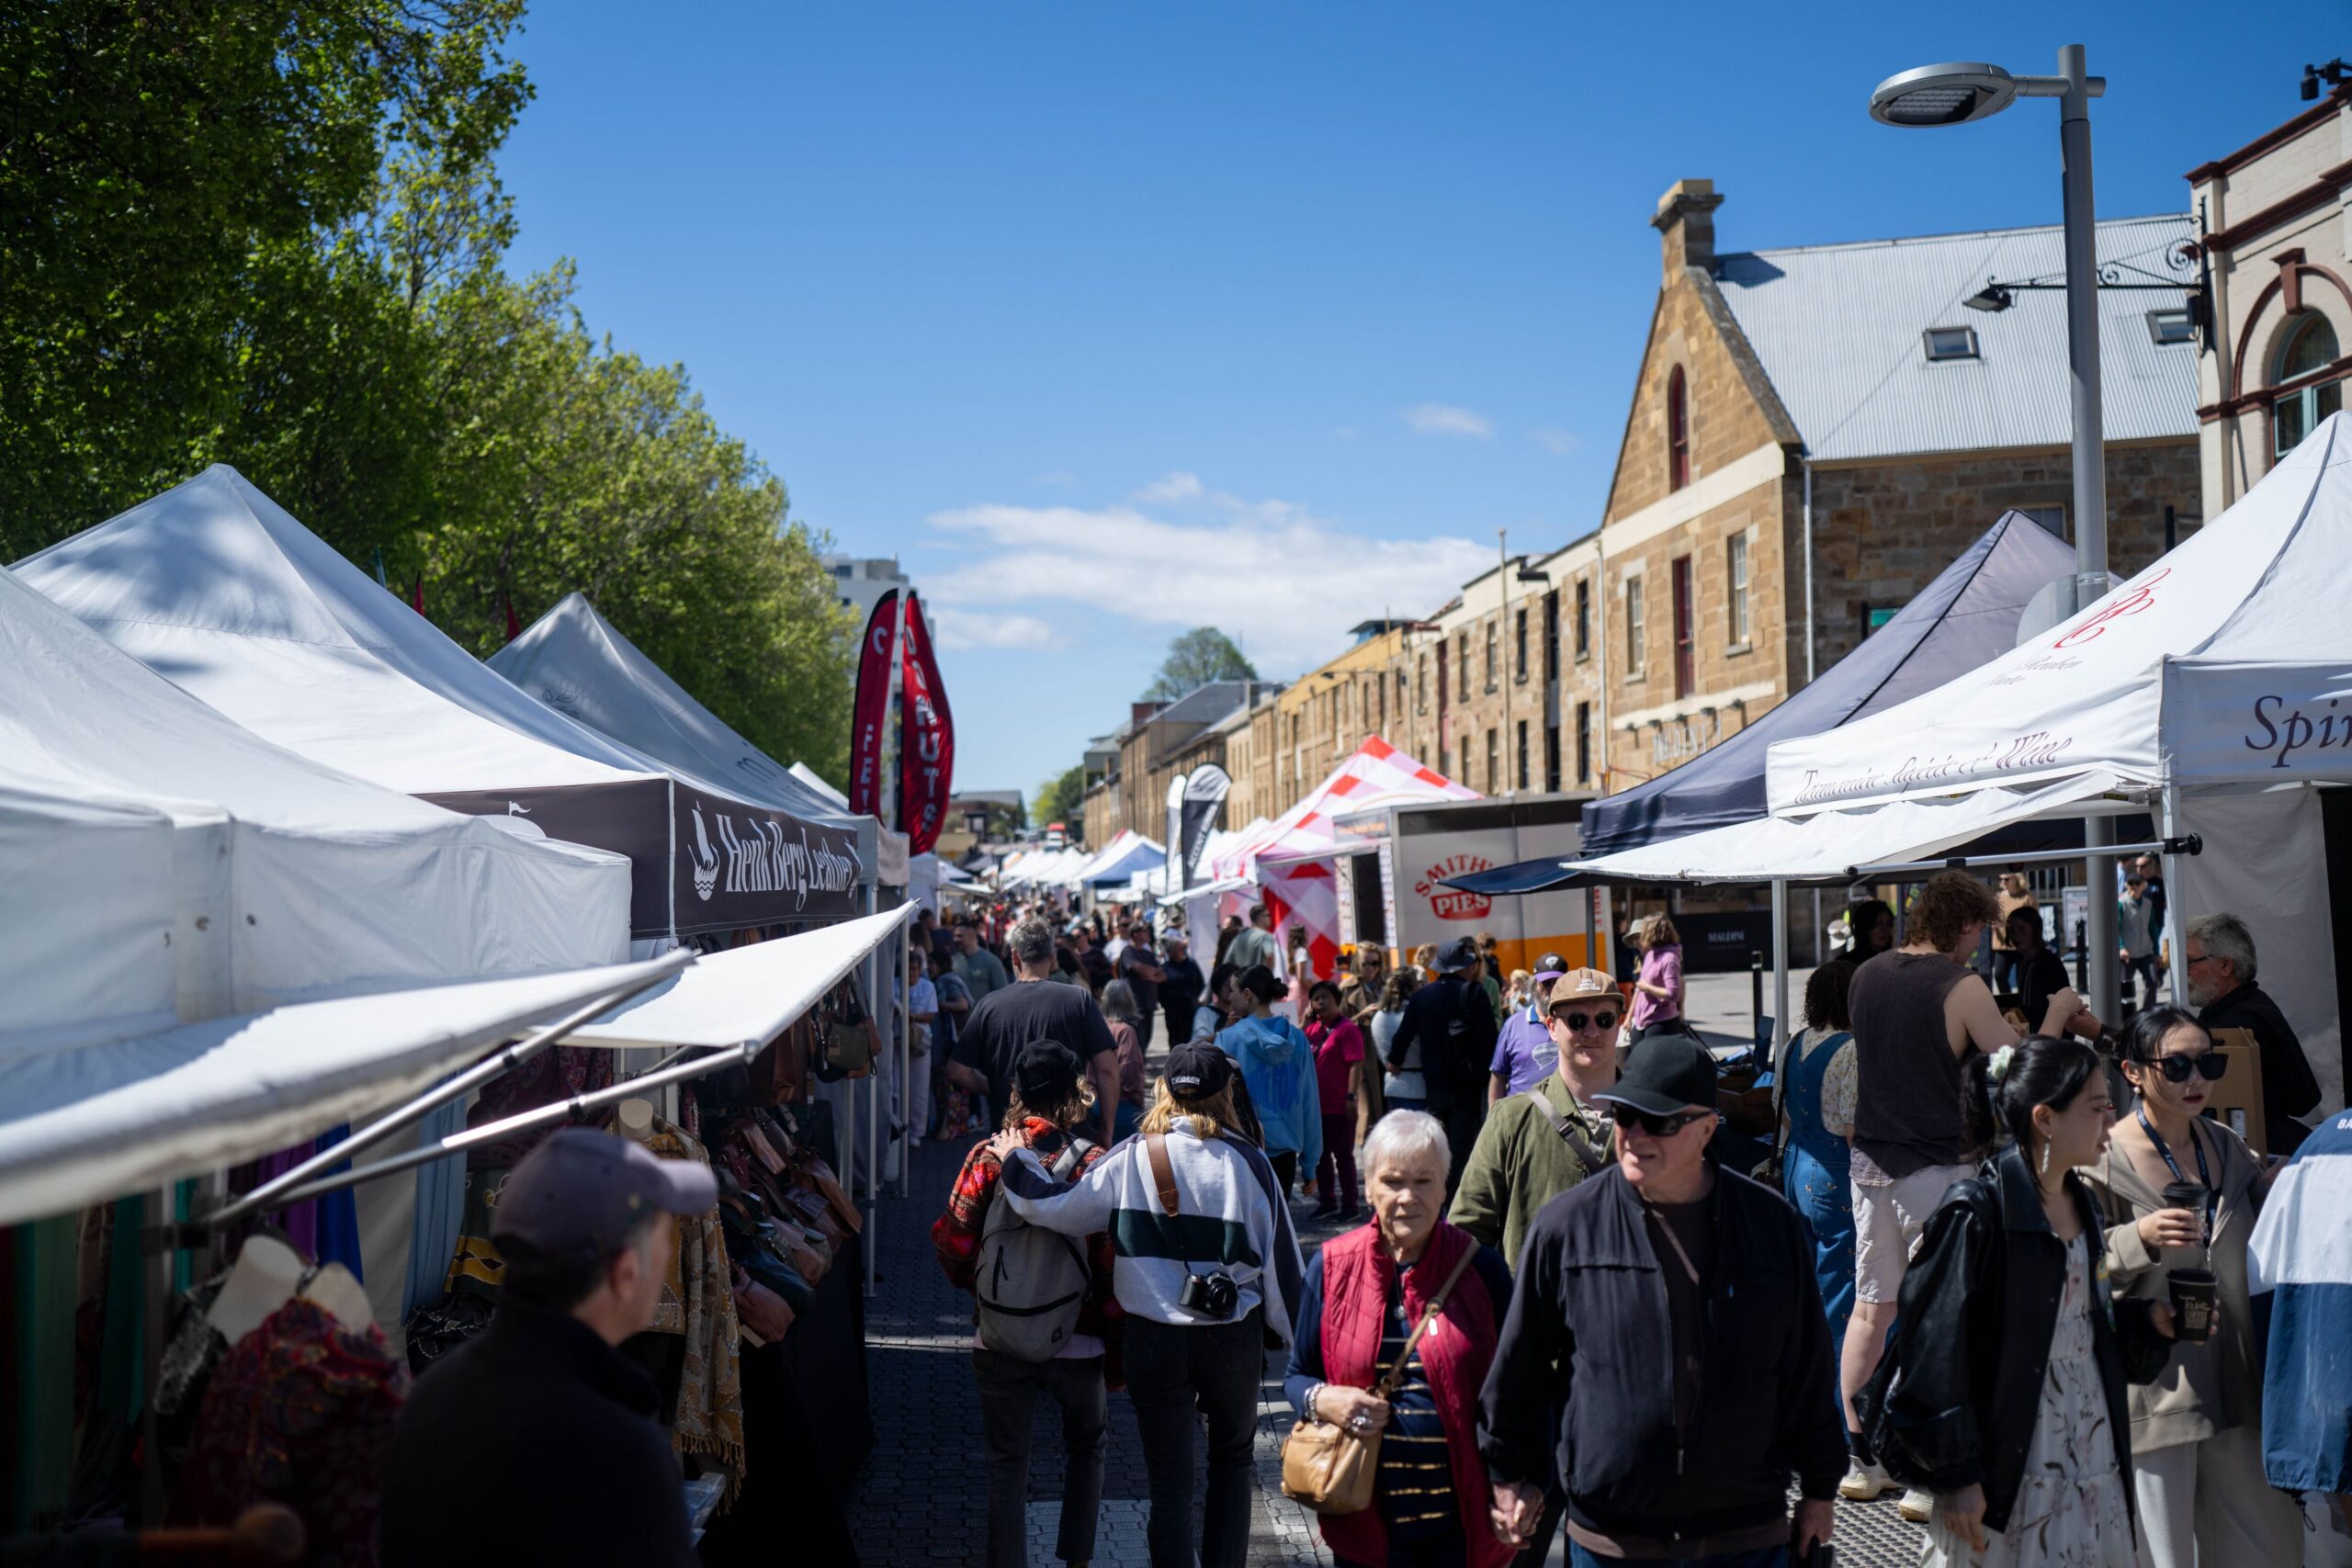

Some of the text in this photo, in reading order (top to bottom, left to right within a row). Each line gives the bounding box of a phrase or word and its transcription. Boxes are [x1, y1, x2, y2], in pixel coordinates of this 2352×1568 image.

[906, 625, 941, 832] DONUTS
[1996, 731, 2073, 770] Wine
[716, 813, 853, 912] Henk Berg Leather
[1415, 854, 1494, 897] SMITH'
[1438, 895, 1488, 916] PIES
